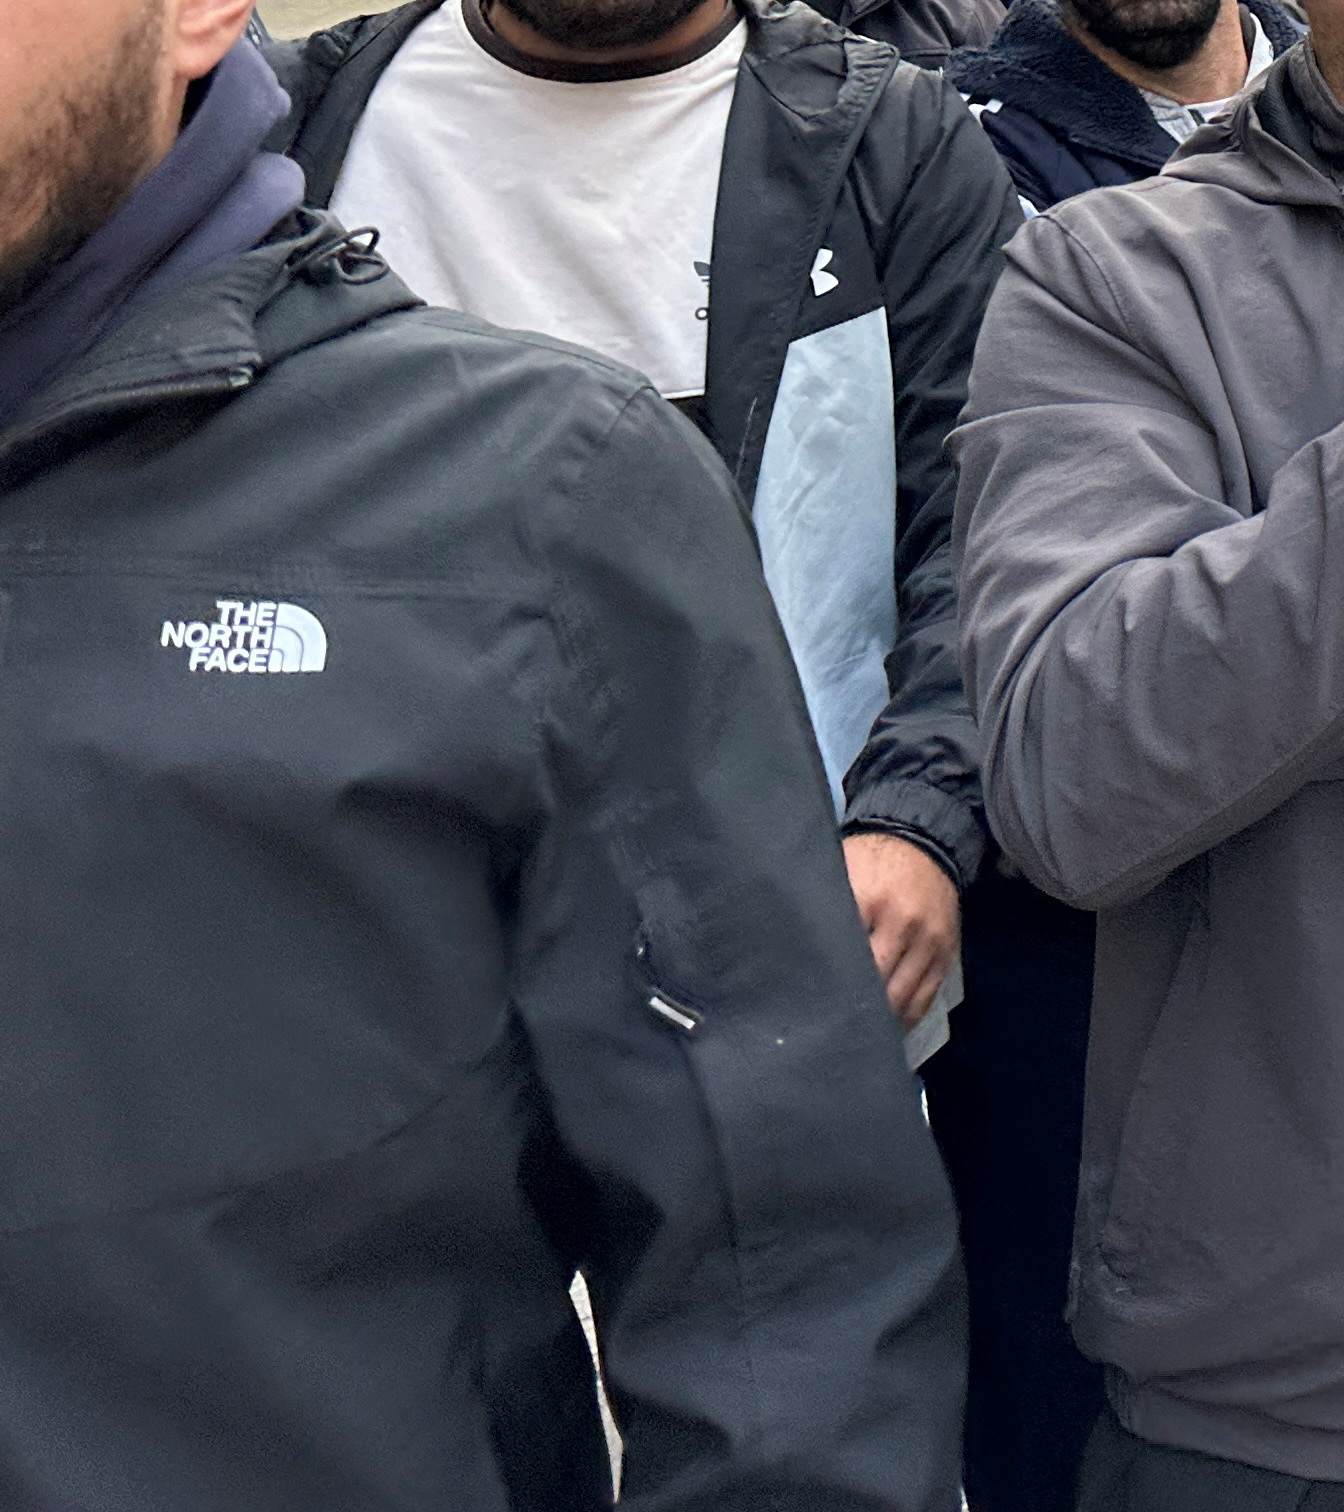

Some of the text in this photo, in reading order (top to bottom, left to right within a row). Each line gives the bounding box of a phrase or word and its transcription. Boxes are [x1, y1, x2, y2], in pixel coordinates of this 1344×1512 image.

[215, 599, 278, 627] THE
[159, 620, 274, 649] NORTH
[188, 647, 269, 673] FACE
